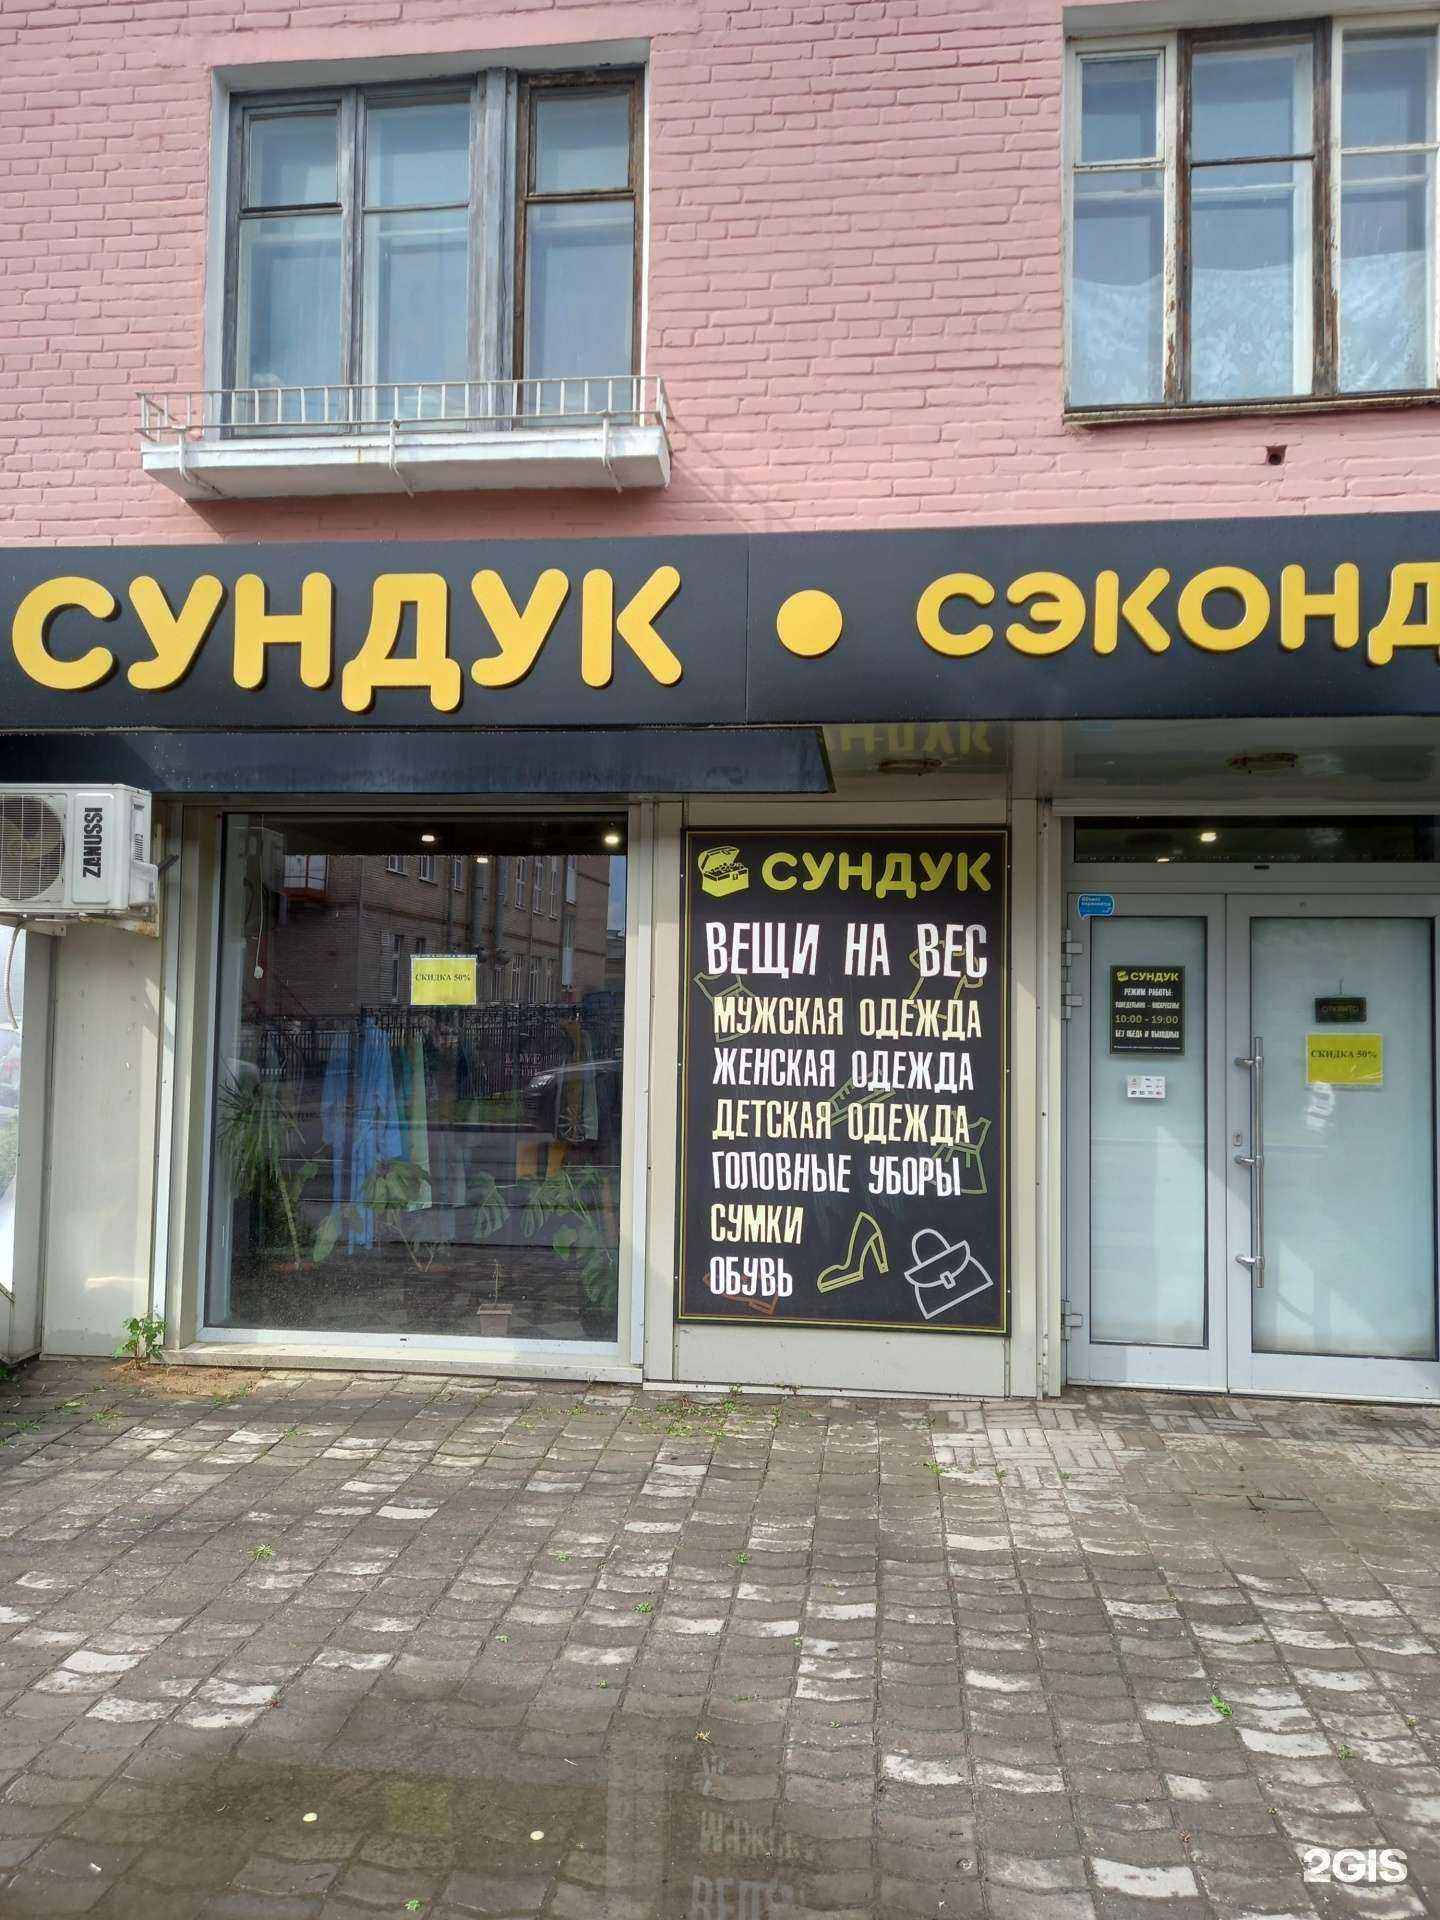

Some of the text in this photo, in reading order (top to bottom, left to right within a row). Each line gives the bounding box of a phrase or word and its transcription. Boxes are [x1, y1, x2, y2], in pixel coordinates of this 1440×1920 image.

[917, 562, 1440, 665] СЭКОНД
[12, 566, 682, 712] СУНДУК
[83, 807, 103, 878] ZANUSSI
[761, 852, 991, 899] СУНДУК
[706, 922, 988, 979] ВЕЩИ НА ВЕС
[415, 973, 471, 982] СКИДКА 50%
[1124, 988, 1146, 996] РЕЖИМ
[1130, 972, 1179, 982] СУНДУК
[713, 997, 982, 1041] МУЖСКАЯ ОДЕЖДА
[1115, 1015, 1142, 1024] 10:00
[1151, 1015, 1178, 1024] 19:00
[713, 1047, 974, 1094] ЖЕНСКАЯ ОДЕЖДА
[1311, 1050, 1377, 1059] СКИДКА 50%
[712, 1099, 971, 1146] ДЕТСКАЯ ОДЕЖДА
[712, 1151, 961, 1197] ГОЛОВНЫЕ УБОРЫ
[711, 1203, 804, 1245] СУМКИ
[709, 1256, 793, 1298] ОБУВЬ
